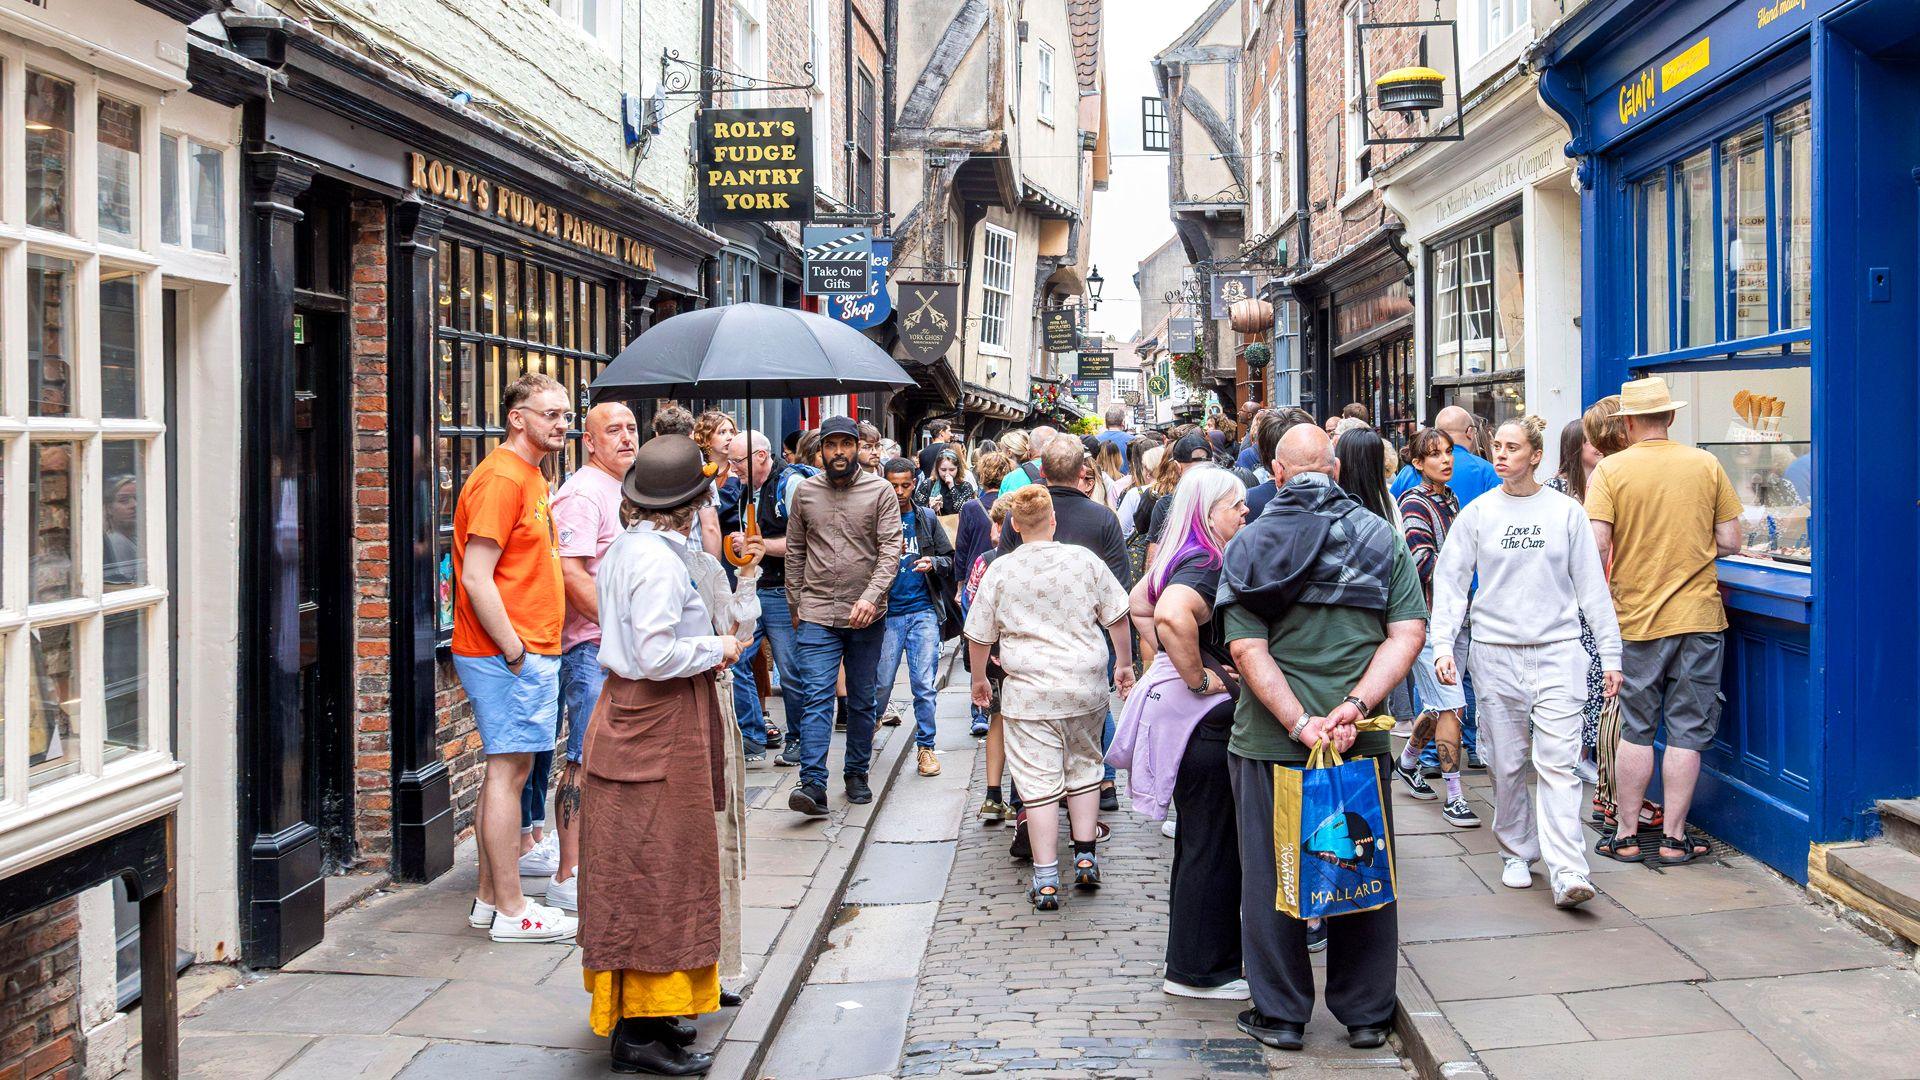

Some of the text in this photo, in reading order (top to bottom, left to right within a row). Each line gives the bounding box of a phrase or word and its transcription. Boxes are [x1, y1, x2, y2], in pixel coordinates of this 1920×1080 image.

[713, 121, 796, 138] ROLY'S
[713, 144, 797, 162] FUDGE
[707, 168, 804, 186] PANTRY
[1435, 203, 1446, 223] The
[1446, 187, 1472, 218] Shambles
[1505, 162, 1517, 188] Pie
[1517, 147, 1553, 181] Company
[722, 192, 791, 210] YORK
[411, 151, 656, 272] ROLY'S FUDGE PANTRY YORK
[811, 266, 863, 277] Take One
[824, 278, 851, 289] Gifts
[841, 301, 875, 321] Shop
[1504, 524, 1542, 536] Love Is
[1501, 536, 1546, 550] The Cure
[1310, 880, 1383, 905] MALLARD
